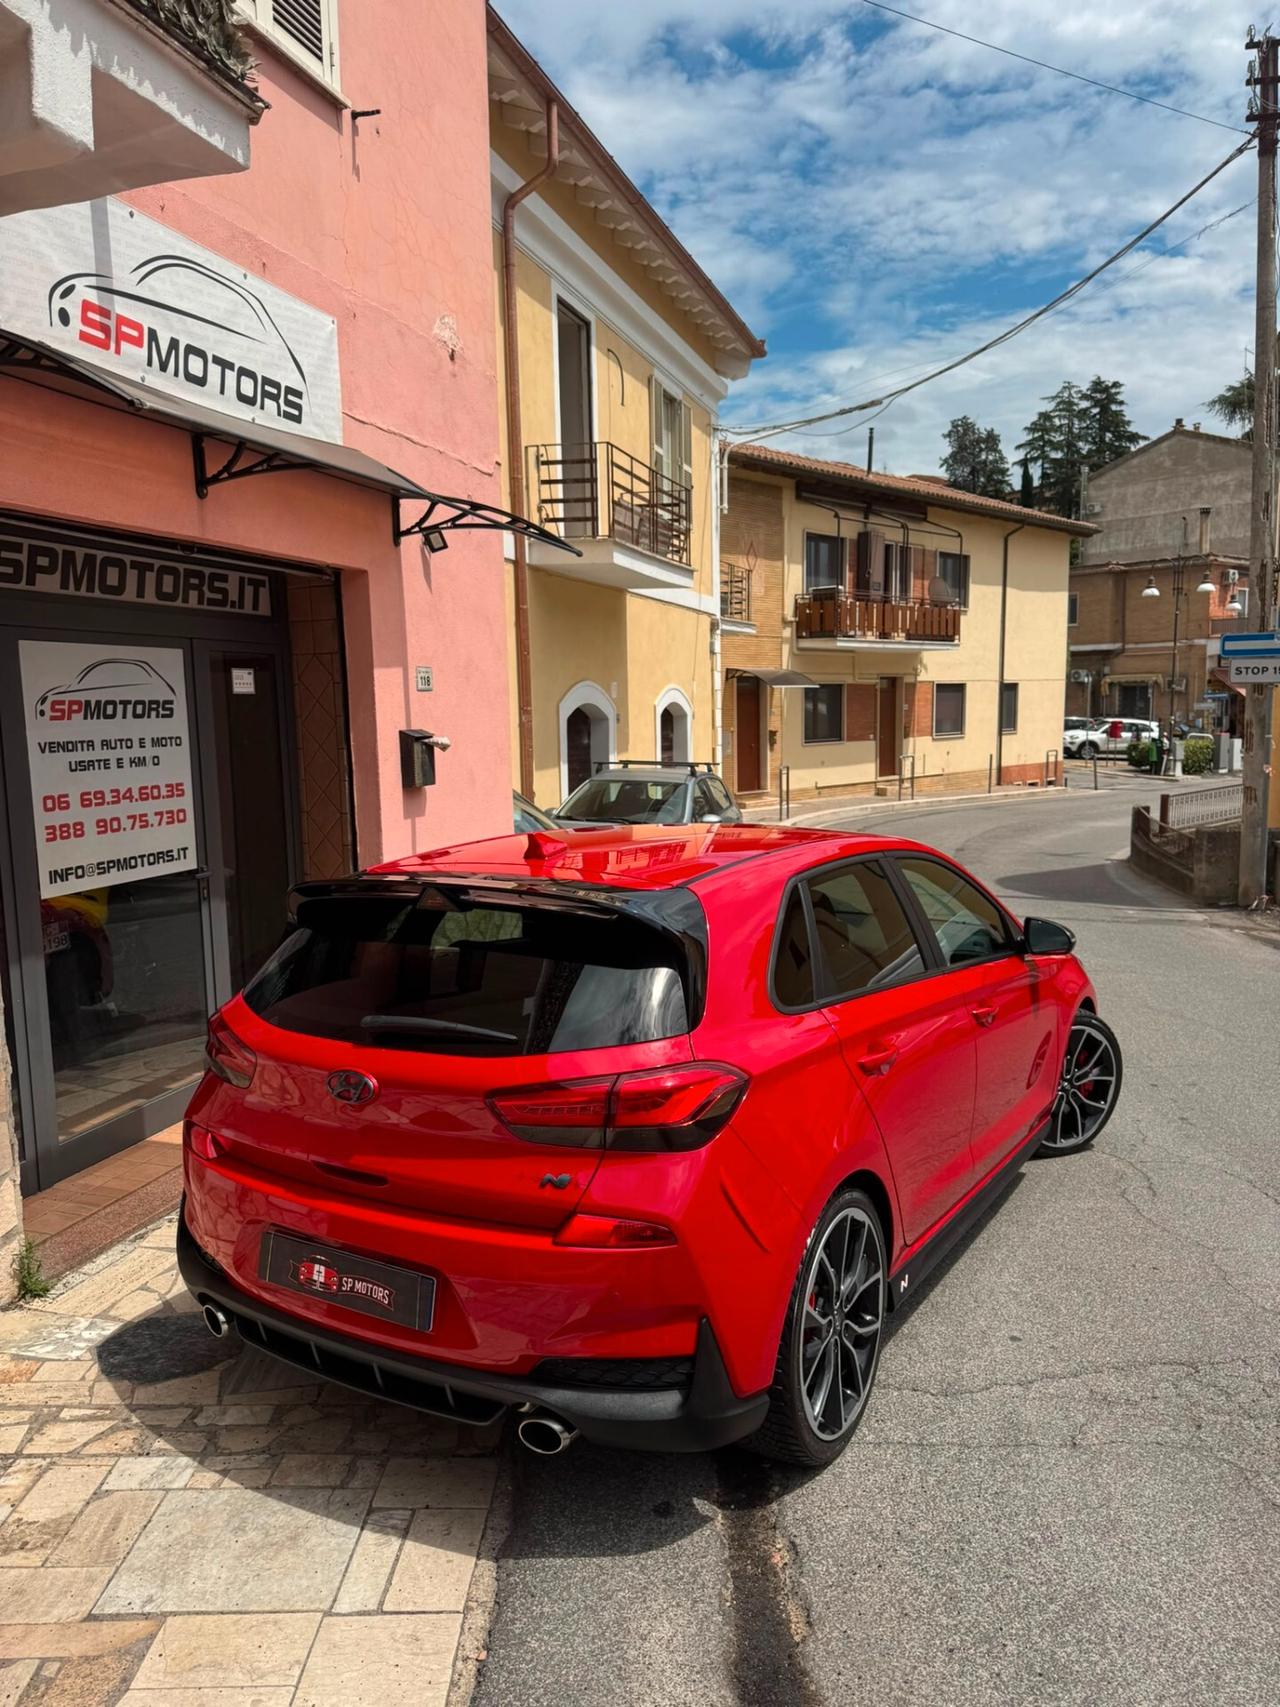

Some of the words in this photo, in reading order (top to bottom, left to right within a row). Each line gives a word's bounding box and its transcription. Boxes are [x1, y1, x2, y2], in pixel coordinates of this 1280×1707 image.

[79, 299, 303, 424] SPMOTORS
[0, 540, 266, 611] SPMOTORS.IT
[1235, 666, 1268, 676] STOP
[49, 700, 174, 721] SPMOTORS
[38, 739, 95, 754] VENDITA
[101, 738, 133, 750] AUTO
[139, 737, 146, 748] E
[151, 736, 182, 748] MOTO
[69, 758, 111, 772] USATE
[116, 757, 124, 768] E
[129, 756, 147, 768] KM
[42, 793, 71, 813] 06
[79, 782, 185, 808] 69.34.60.35
[44, 821, 85, 843] 388
[95, 808, 187, 835] 90.75.730
[48, 847, 189, 885] INFO@SPMOTORS.IT
[342, 1277, 354, 1291] SP
[354, 1280, 390, 1304] MOTORS
